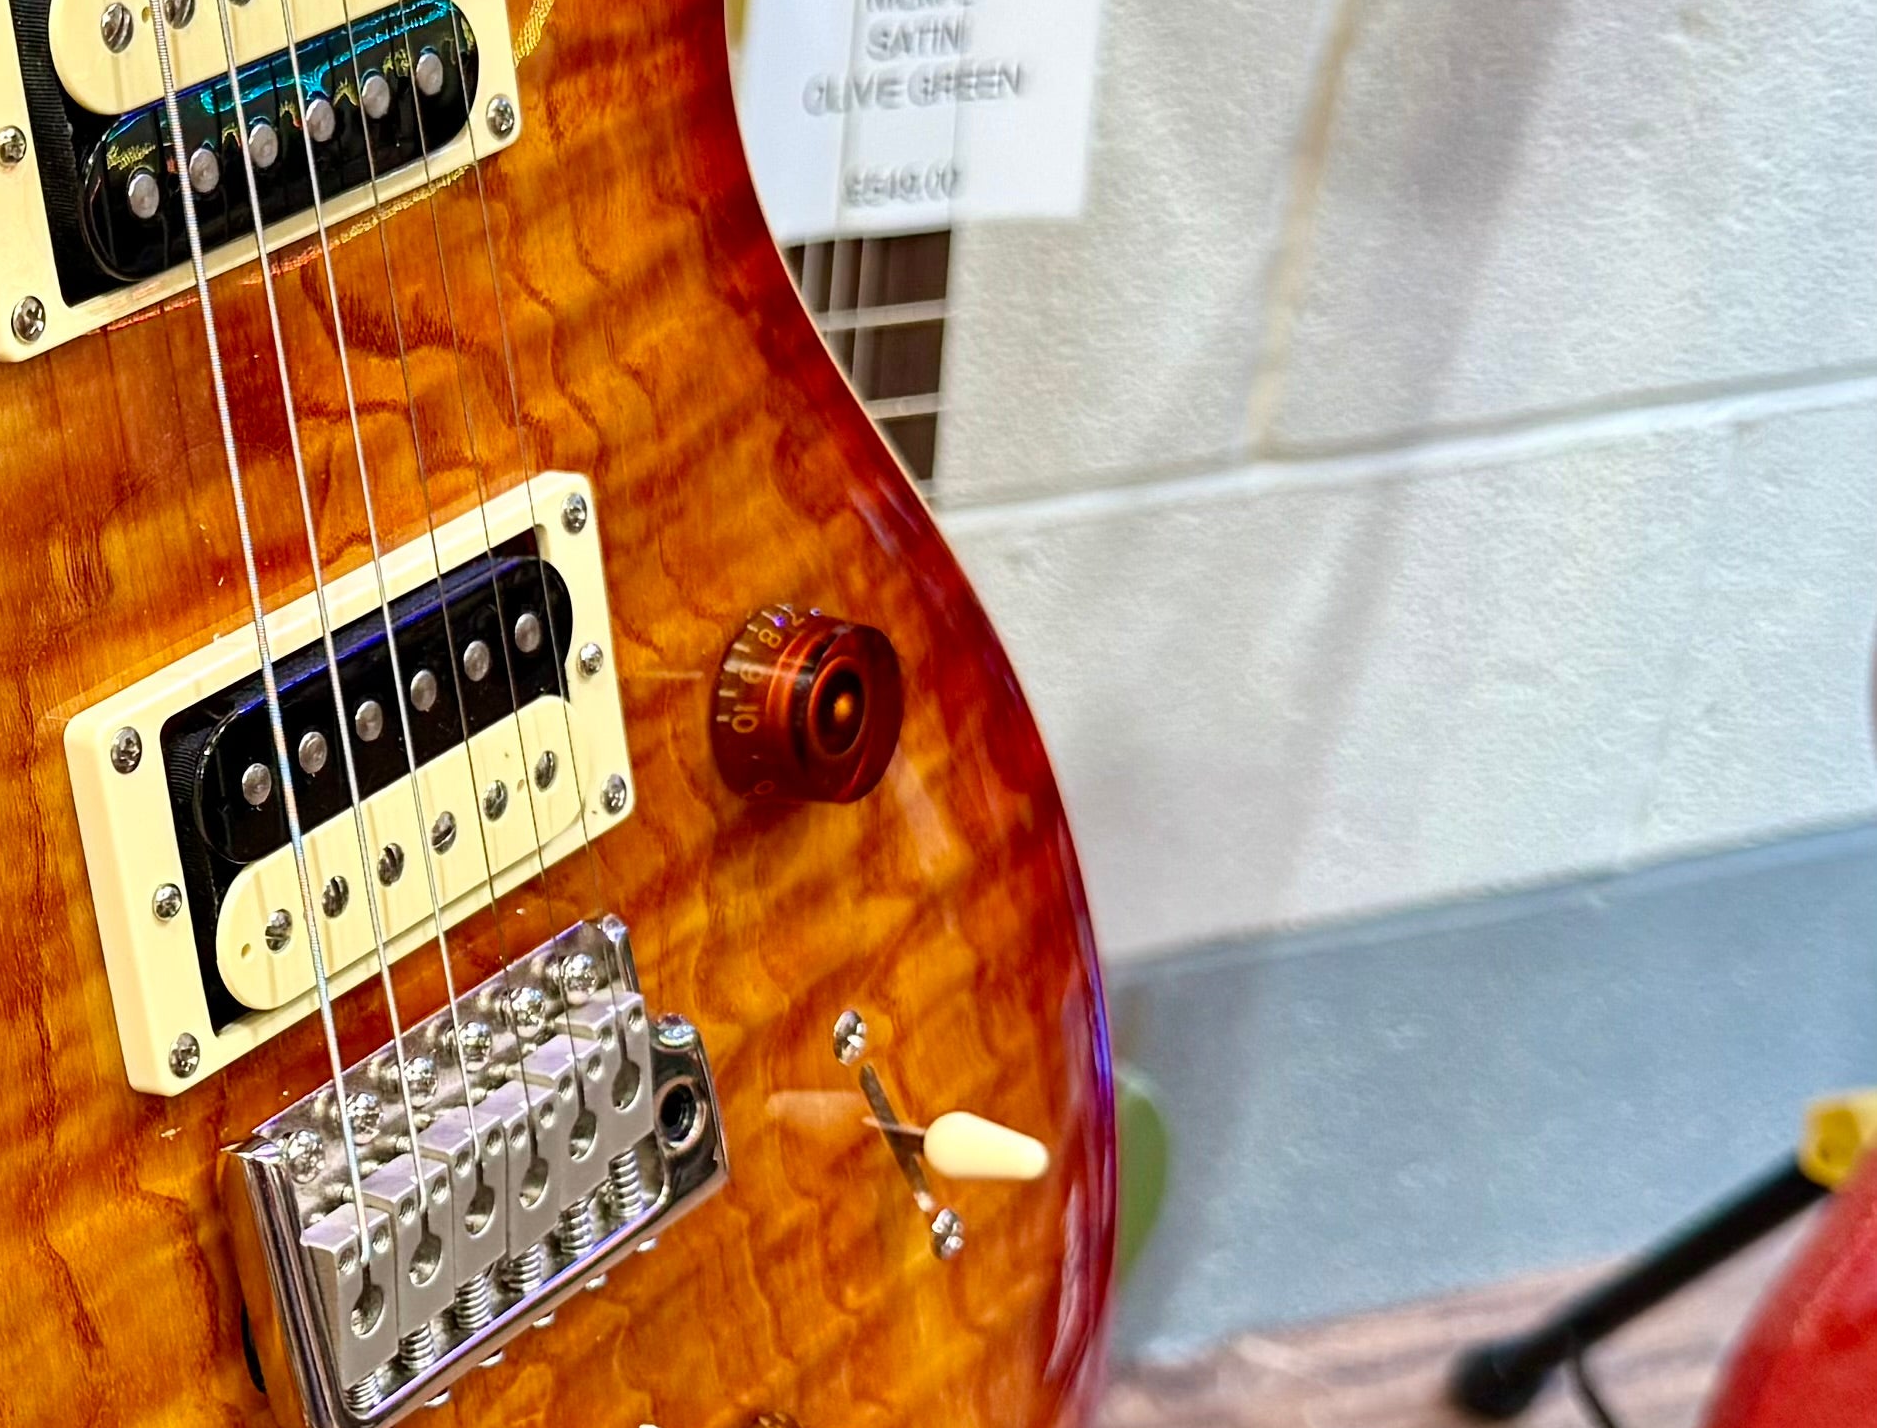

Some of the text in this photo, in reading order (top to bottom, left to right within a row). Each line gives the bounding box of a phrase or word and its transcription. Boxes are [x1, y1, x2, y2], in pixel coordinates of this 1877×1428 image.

[866, 17, 972, 61] SATIN
[802, 58, 1028, 117] OLIVE GREEN
[758, 628, 782, 649] 8
